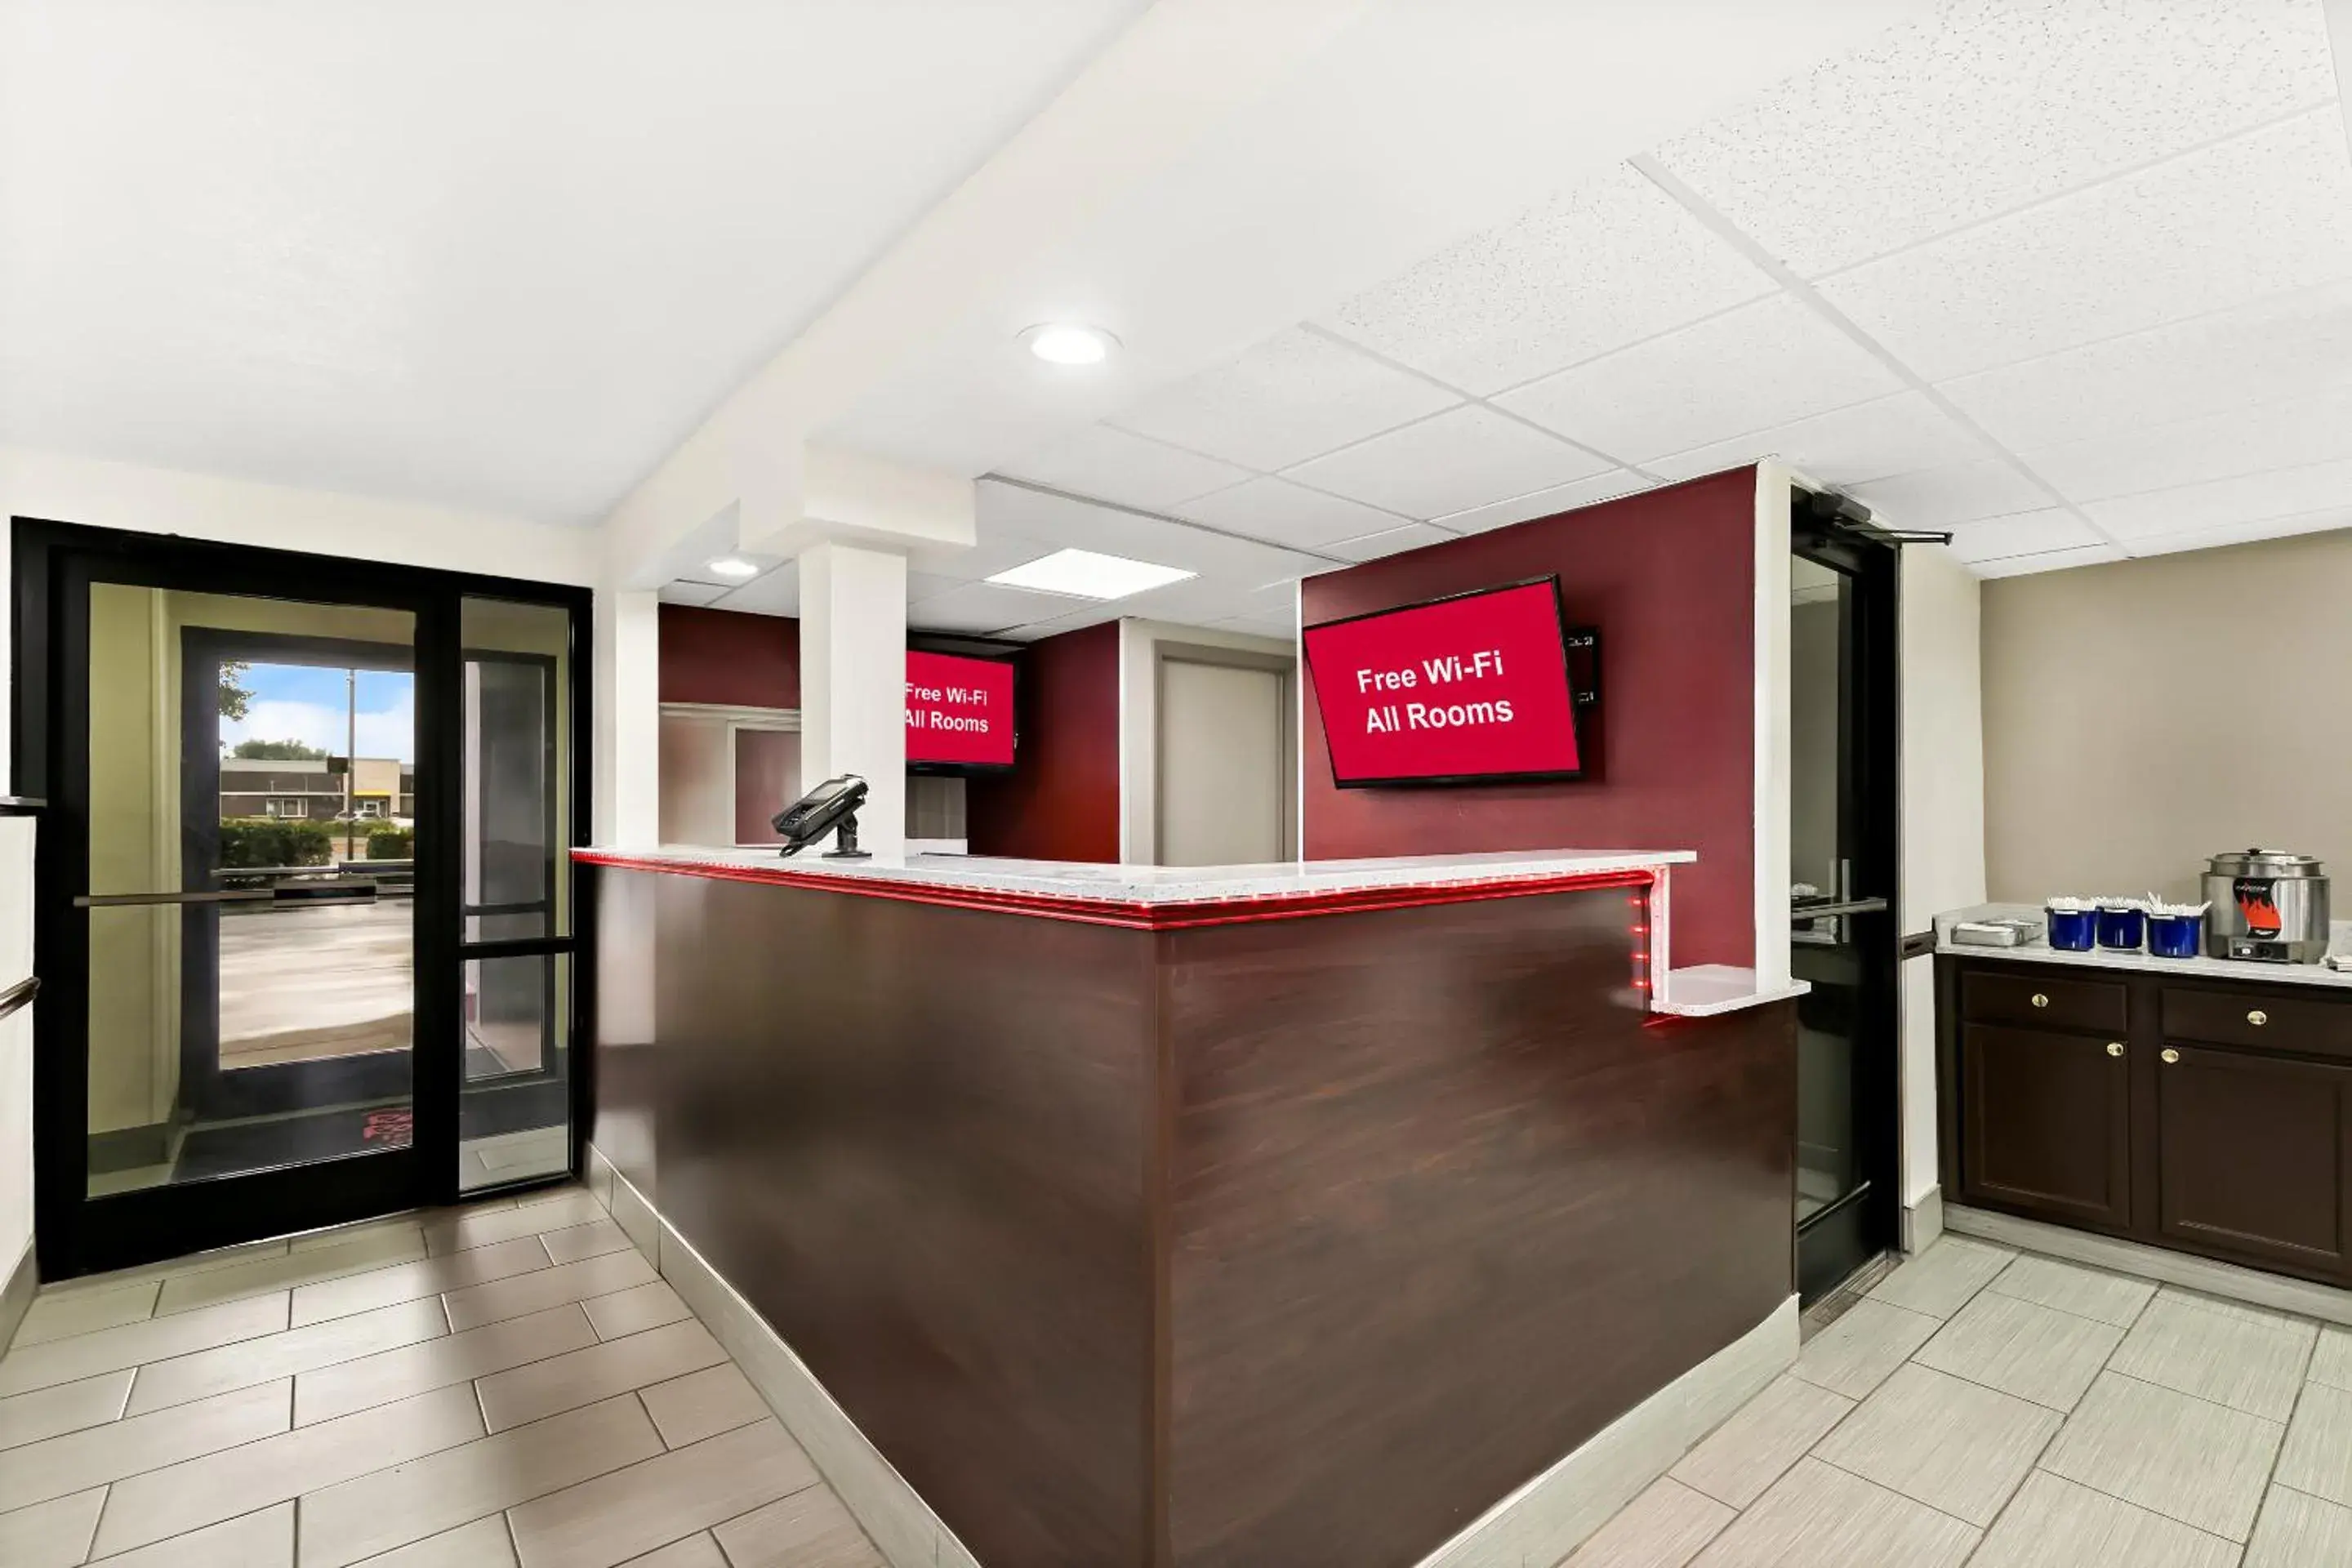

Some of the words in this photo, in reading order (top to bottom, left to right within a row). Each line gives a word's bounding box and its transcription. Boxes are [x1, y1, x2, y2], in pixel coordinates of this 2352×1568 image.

[1356, 669, 1417, 693] Free
[1423, 650, 1503, 684] Wi-Fi
[904, 683, 942, 702] Free
[946, 687, 987, 706] Wi-Fi
[905, 709, 925, 728] All
[930, 710, 989, 733] Rooms
[1366, 705, 1401, 733] All
[1406, 700, 1514, 730] Rooms
